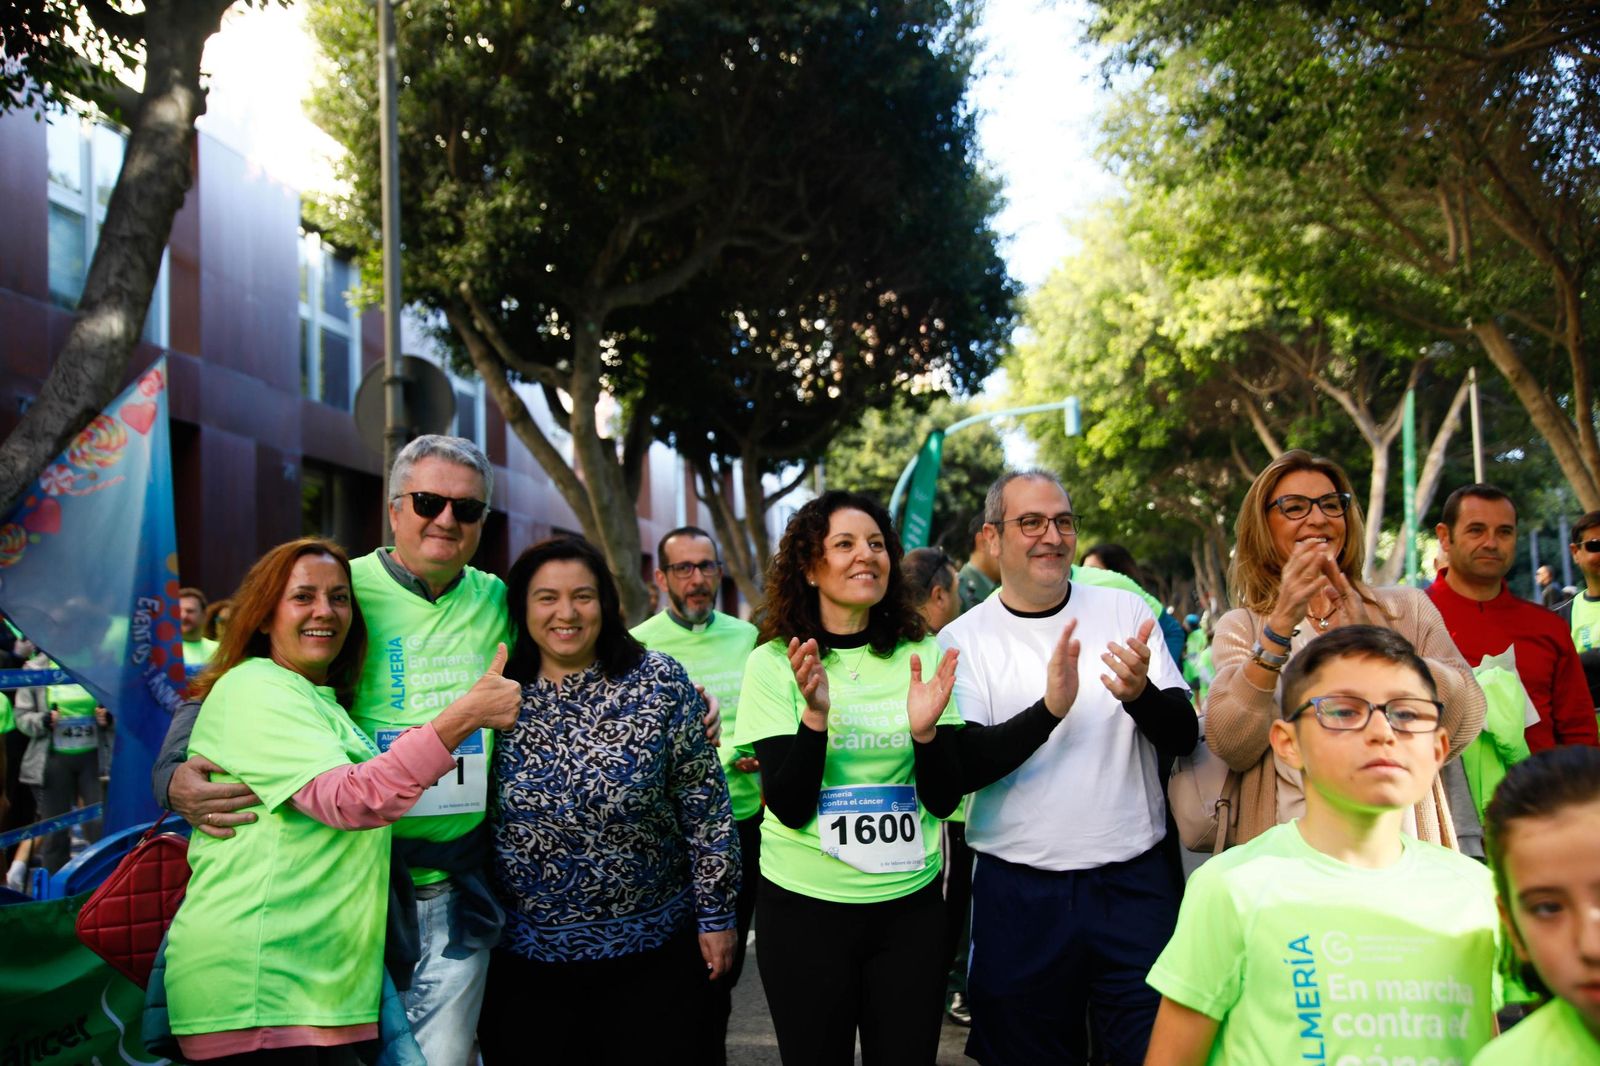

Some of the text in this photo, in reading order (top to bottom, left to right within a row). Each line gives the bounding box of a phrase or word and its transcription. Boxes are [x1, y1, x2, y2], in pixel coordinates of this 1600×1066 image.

[386, 636, 405, 710] ALMERÍA
[408, 654, 428, 669] En
[410, 669, 469, 687] contra
[830, 713, 889, 729] contra
[830, 727, 911, 750] cáncer
[822, 797, 885, 808] contra el cáncer
[831, 813, 915, 846] 1600
[1283, 934, 1326, 1066] LMERÍA
[1327, 973, 1474, 1007] En marcha
[1332, 1006, 1471, 1040] contra el
